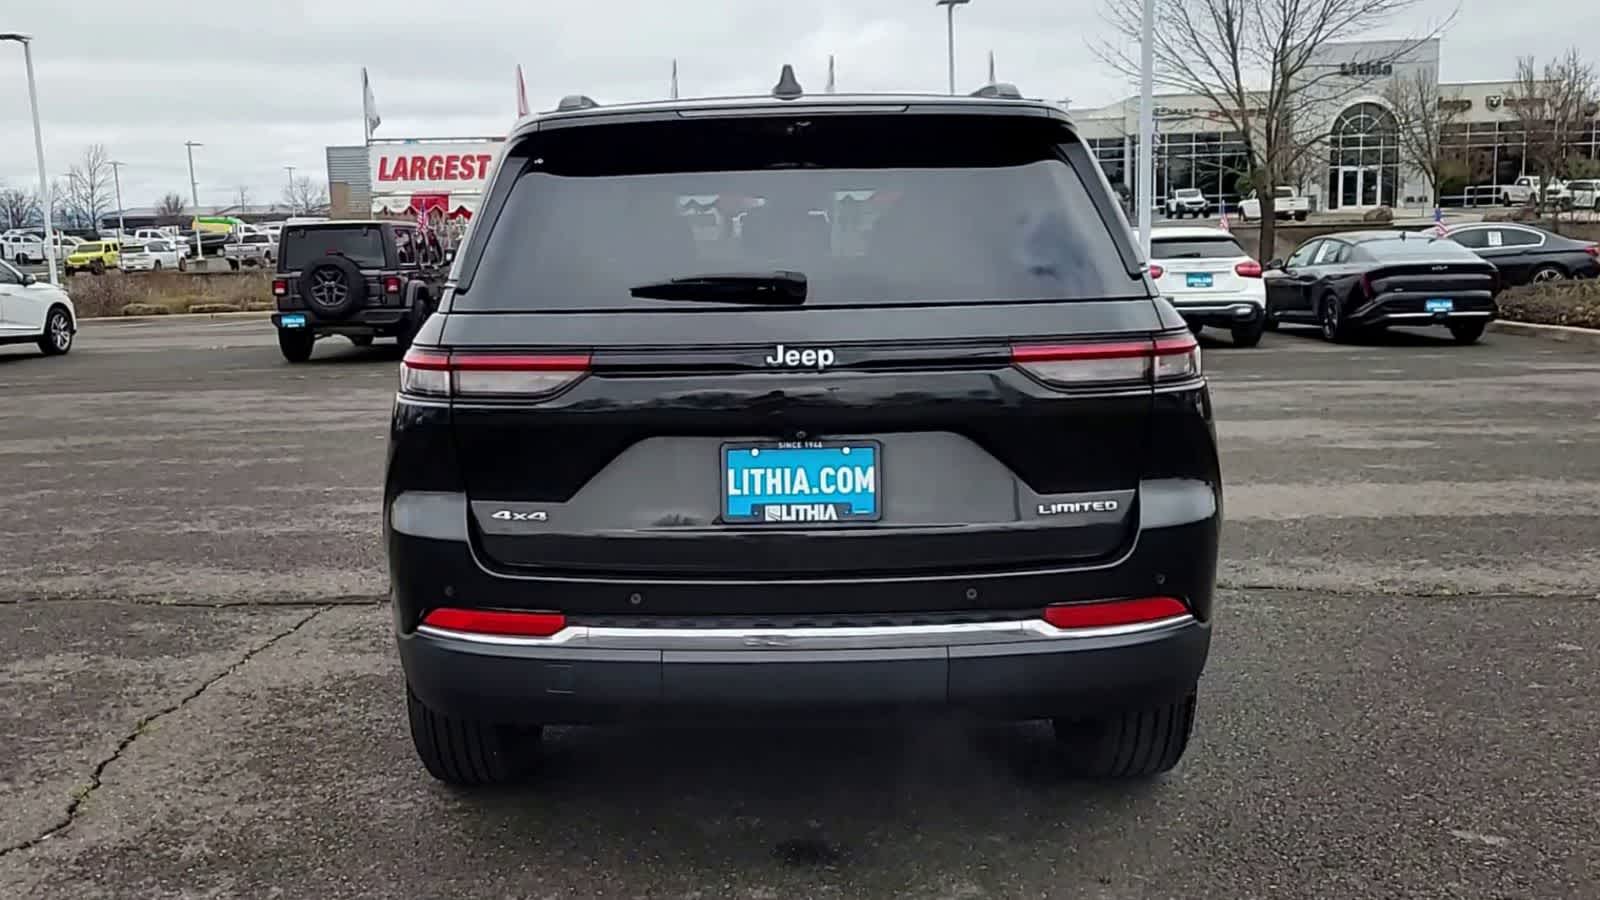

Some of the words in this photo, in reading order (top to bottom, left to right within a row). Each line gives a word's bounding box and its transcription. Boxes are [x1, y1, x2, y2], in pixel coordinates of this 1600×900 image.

[378, 154, 492, 181] LARGEST
[766, 344, 834, 370] Jeep
[778, 441, 801, 449] SINCE
[728, 466, 875, 496] LITHIA.COM
[491, 510, 546, 520] 4x4
[783, 504, 838, 521] LITHIA
[1038, 501, 1117, 514] LIMITED
